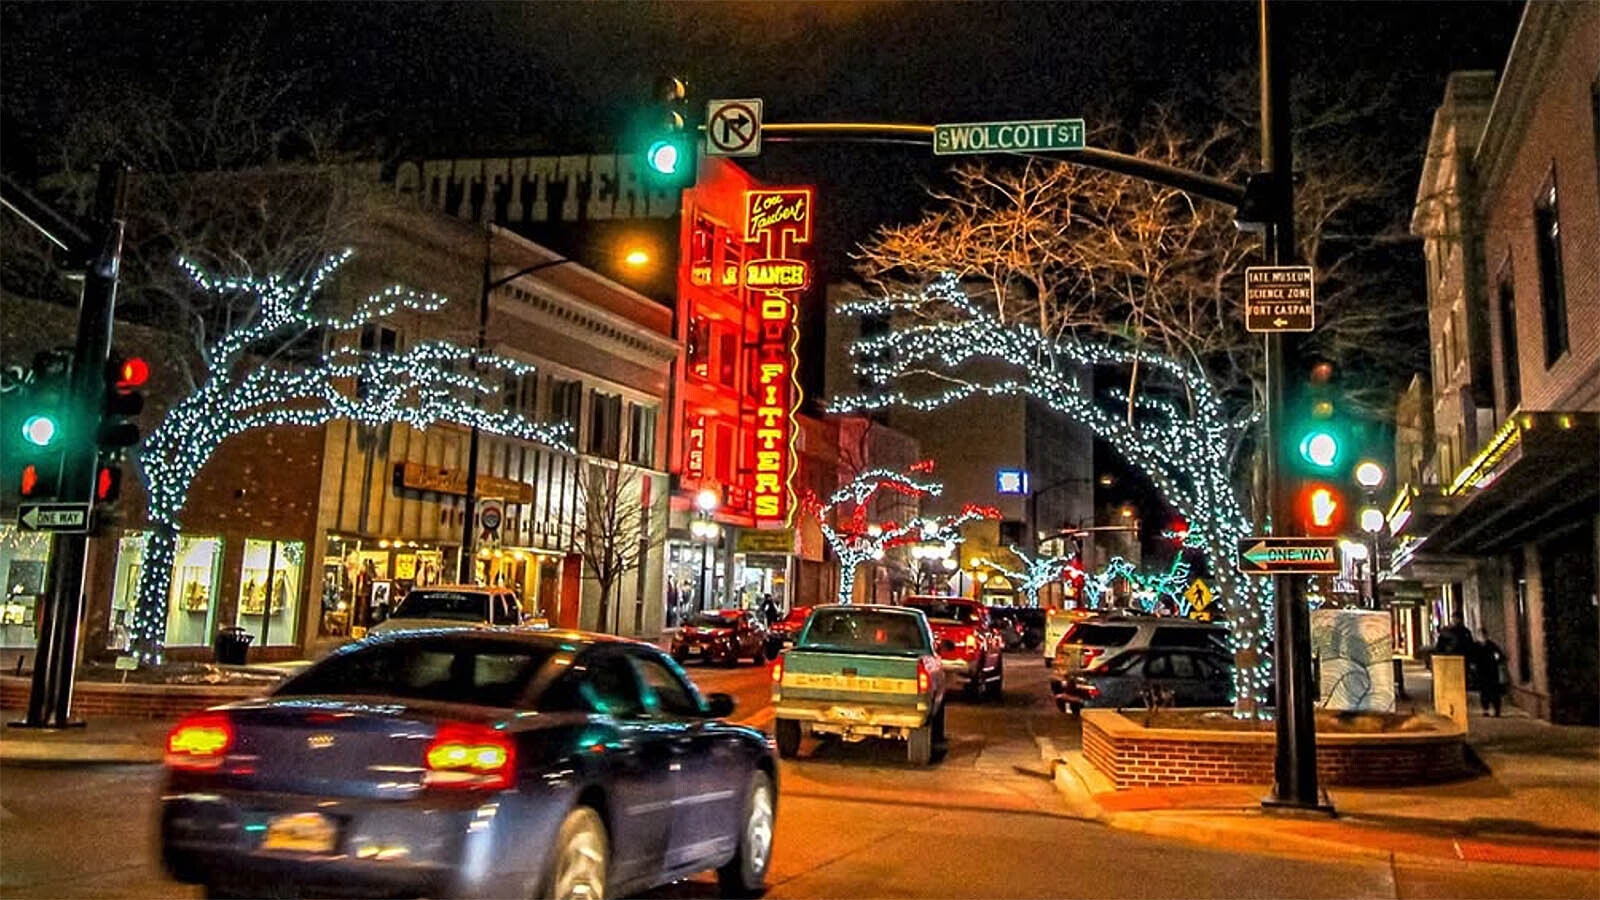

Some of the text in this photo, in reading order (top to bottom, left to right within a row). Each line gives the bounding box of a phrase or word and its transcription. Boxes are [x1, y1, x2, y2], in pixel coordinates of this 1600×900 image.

[938, 124, 1081, 150] S WOLCOTT ST
[752, 194, 783, 214] Lou
[750, 198, 805, 236] Taubert
[747, 265, 804, 285] RANCH
[1272, 271, 1311, 283] MUSEUM
[1248, 287, 1310, 299] SCIENCE ZONE
[1247, 305, 1313, 316] FORT CASPAR
[38, 510, 80, 523] ONE WAY
[1268, 548, 1329, 561] ONE WAY
[795, 676, 905, 690] CHEVOLET
